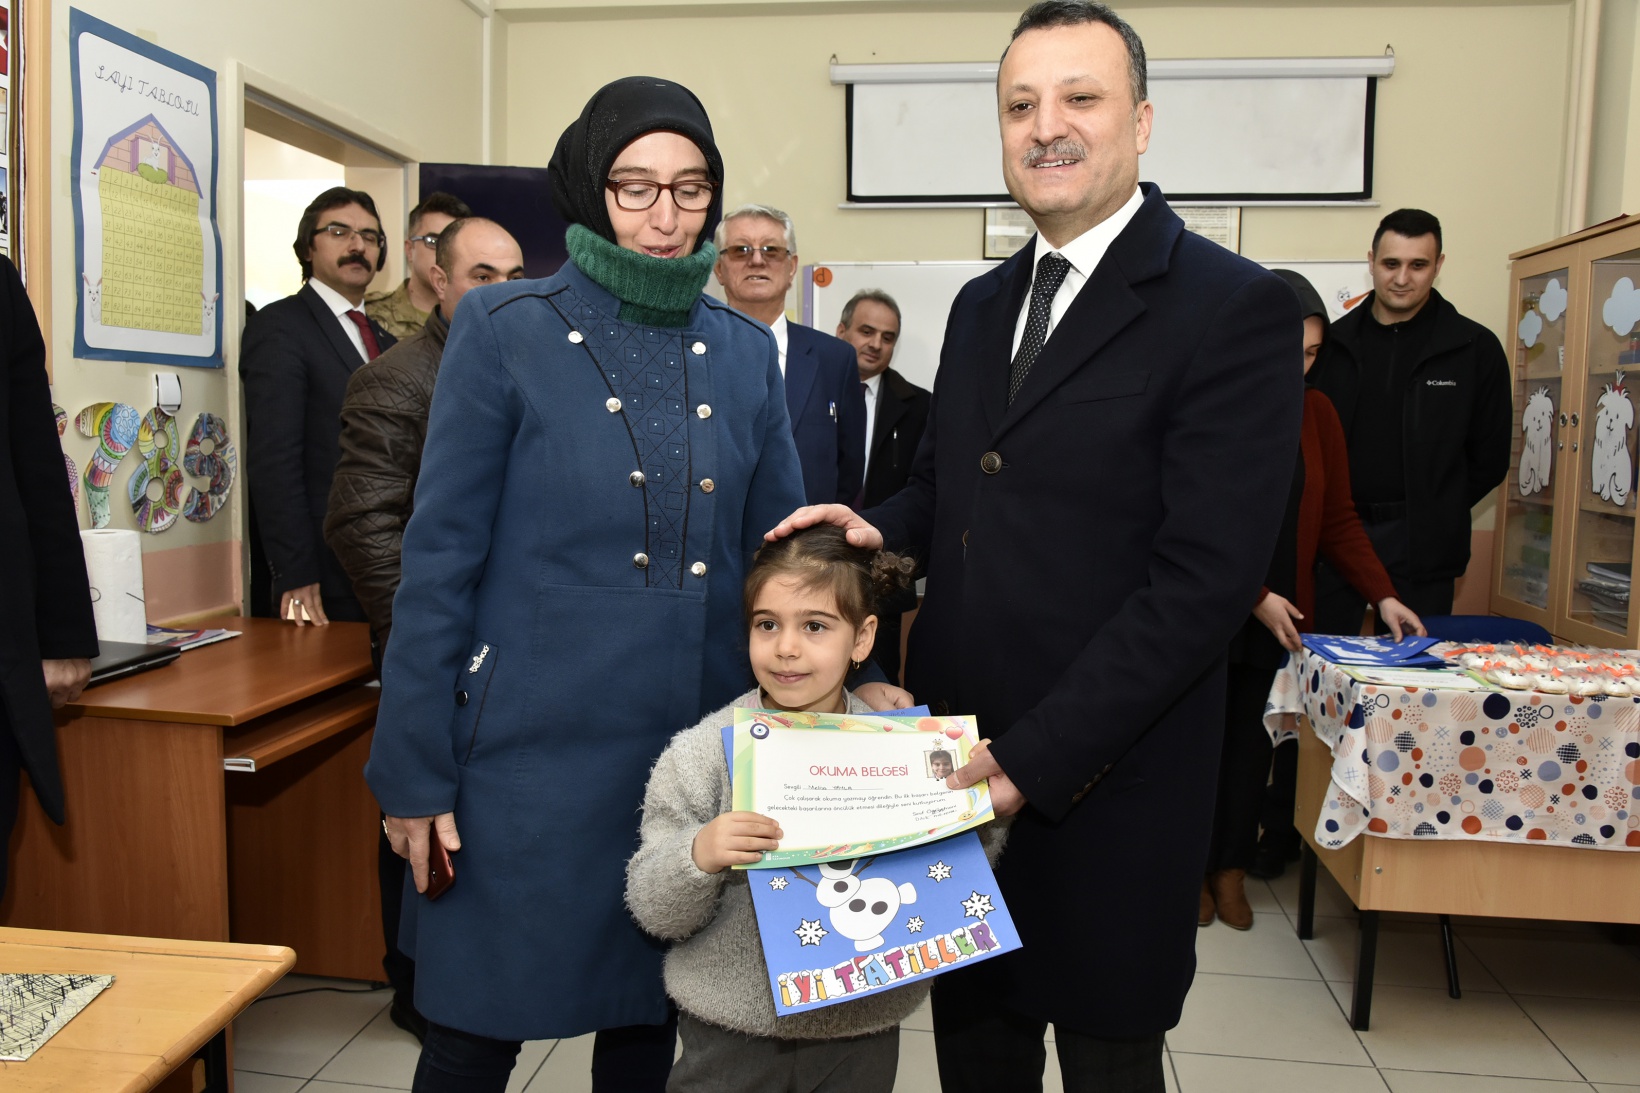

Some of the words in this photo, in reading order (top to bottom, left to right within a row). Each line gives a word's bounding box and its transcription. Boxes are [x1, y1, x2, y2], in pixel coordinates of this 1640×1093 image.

[94, 65, 132, 93] SAYI
[138, 80, 200, 116] TABLOSU
[809, 765, 858, 776] OKUMA
[861, 765, 908, 776] BELGESİ
